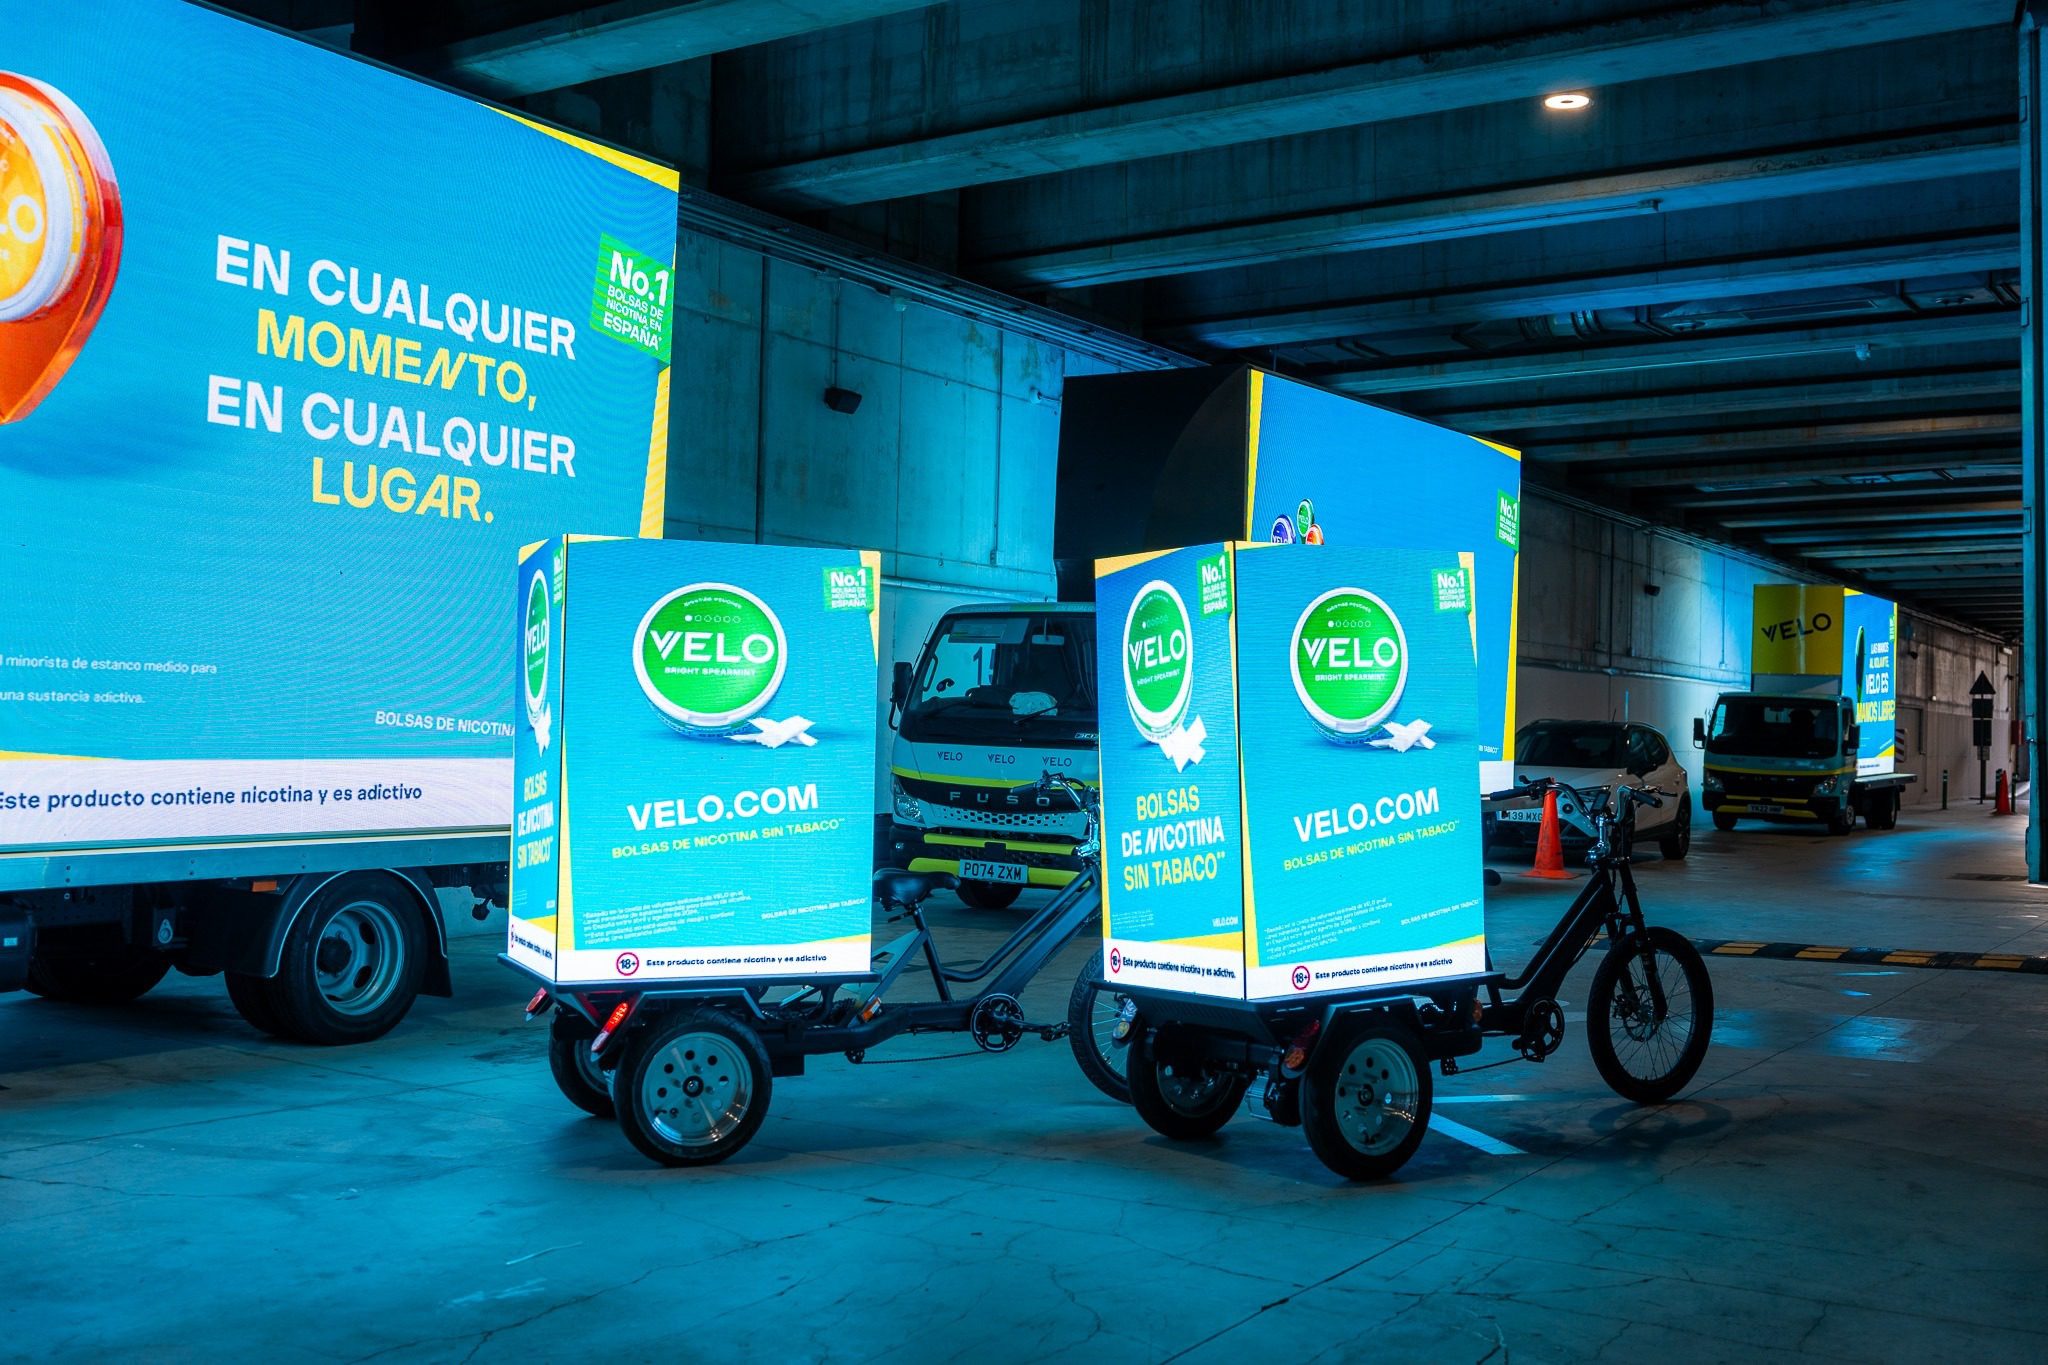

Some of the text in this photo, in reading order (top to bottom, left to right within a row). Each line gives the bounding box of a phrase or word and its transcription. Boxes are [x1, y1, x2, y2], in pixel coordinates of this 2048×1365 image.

[610, 250, 669, 307] No.1
[215, 234, 576, 360] EN CUALQUIER
[607, 284, 664, 321] BOLSAS DE
[606, 297, 661, 332] NICOTINA EN
[256, 309, 537, 411] MOMENTO,
[207, 374, 576, 477] EN CUALQUIER
[311, 457, 494, 523] LUGAR.
[831, 568, 866, 586] No.1
[1202, 555, 1226, 585] No.1
[1437, 569, 1464, 588] No.1
[1761, 612, 1832, 642] VELO
[649, 630, 775, 664] VELO
[1129, 629, 1185, 671] VELO
[1302, 636, 1398, 668] VELO
[6, 655, 68, 668] minorista
[72, 657, 88, 669] de
[91, 660, 141, 671] estanco
[143, 661, 189, 673] medido
[191, 663, 217, 675] para
[0, 691, 24, 701] una
[27, 690, 90, 702] sustancia
[375, 710, 433, 729] BOLSAS
[436, 717, 455, 731] DE
[937, 751, 1072, 767] VELO VELO VELO
[48, 789, 145, 812] producto
[151, 787, 235, 806] contiene
[241, 786, 313, 803] nicotina
[318, 789, 328, 805] y
[333, 788, 352, 800] es
[358, 783, 422, 801] adictivo
[627, 783, 819, 831] VELO.COM
[949, 791, 1050, 807] FUSO
[1136, 785, 1200, 821] BOLSAS
[1293, 786, 1440, 843] VELO.COM
[612, 840, 669, 859] BOLSAS
[673, 838, 690, 850] DE
[694, 830, 758, 848] NICOTINA
[762, 827, 784, 839] SIN
[1121, 815, 1225, 858] DE NICOTINA
[1284, 851, 1328, 871] BOLSAS
[1330, 847, 1344, 860] DE
[1346, 836, 1396, 856] NICOTINA
[1397, 831, 1414, 844] SIN
[998, 865, 1021, 880] ZXM
[1124, 863, 1149, 891] SIN
[620, 959, 637, 969] 18+
[646, 958, 664, 966] Este
[667, 957, 705, 967] producto
[707, 956, 741, 965] contiene
[743, 955, 776, 964] nicotina
[795, 954, 827, 962] adictivo
[1123, 957, 1133, 966] Este
[1134, 959, 1156, 970] producto
[1180, 963, 1200, 974] nicotina
[1295, 972, 1308, 983] 18+
[1331, 969, 1360, 979] producto
[1361, 965, 1389, 975] contiene
[1390, 963, 1414, 971] nicotina
[1428, 958, 1453, 966] adictivo
